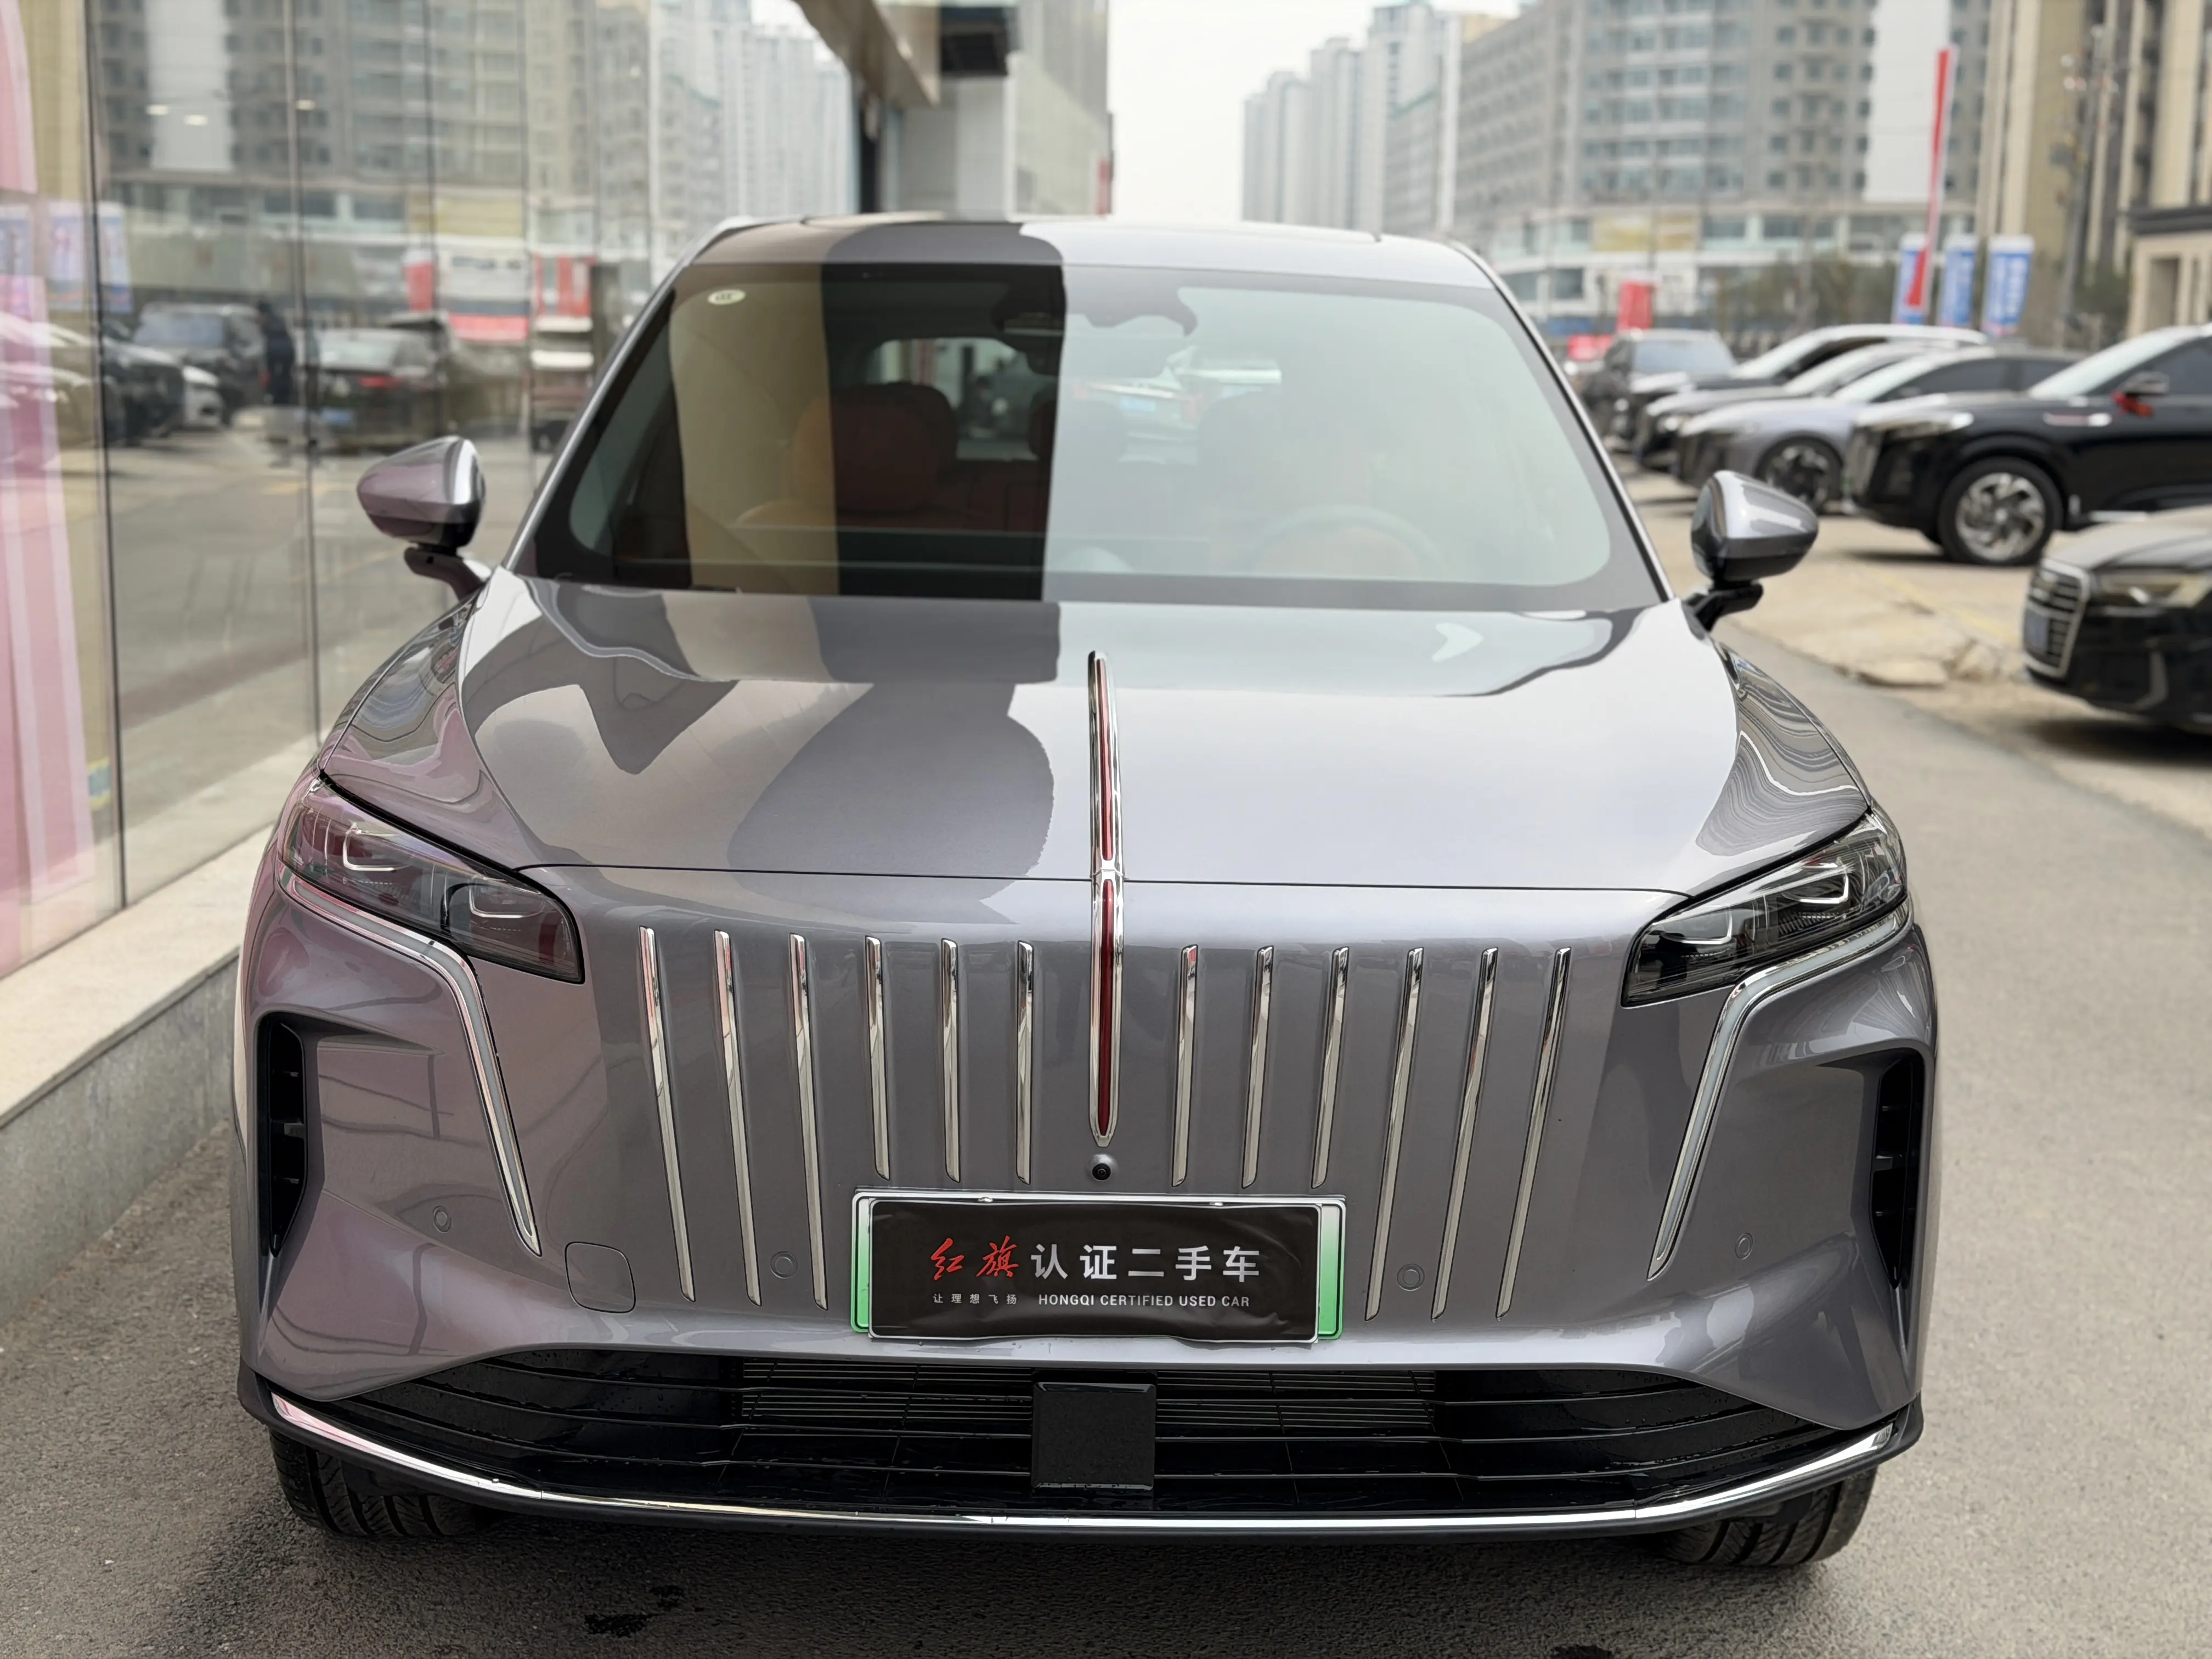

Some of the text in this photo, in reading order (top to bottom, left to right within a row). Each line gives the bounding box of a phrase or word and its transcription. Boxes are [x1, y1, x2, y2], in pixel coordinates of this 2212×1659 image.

[933, 1293, 1017, 1305] 让理想飞扬
[1039, 1294, 1250, 1307] HONGQI CERTIFIED USED CAR
